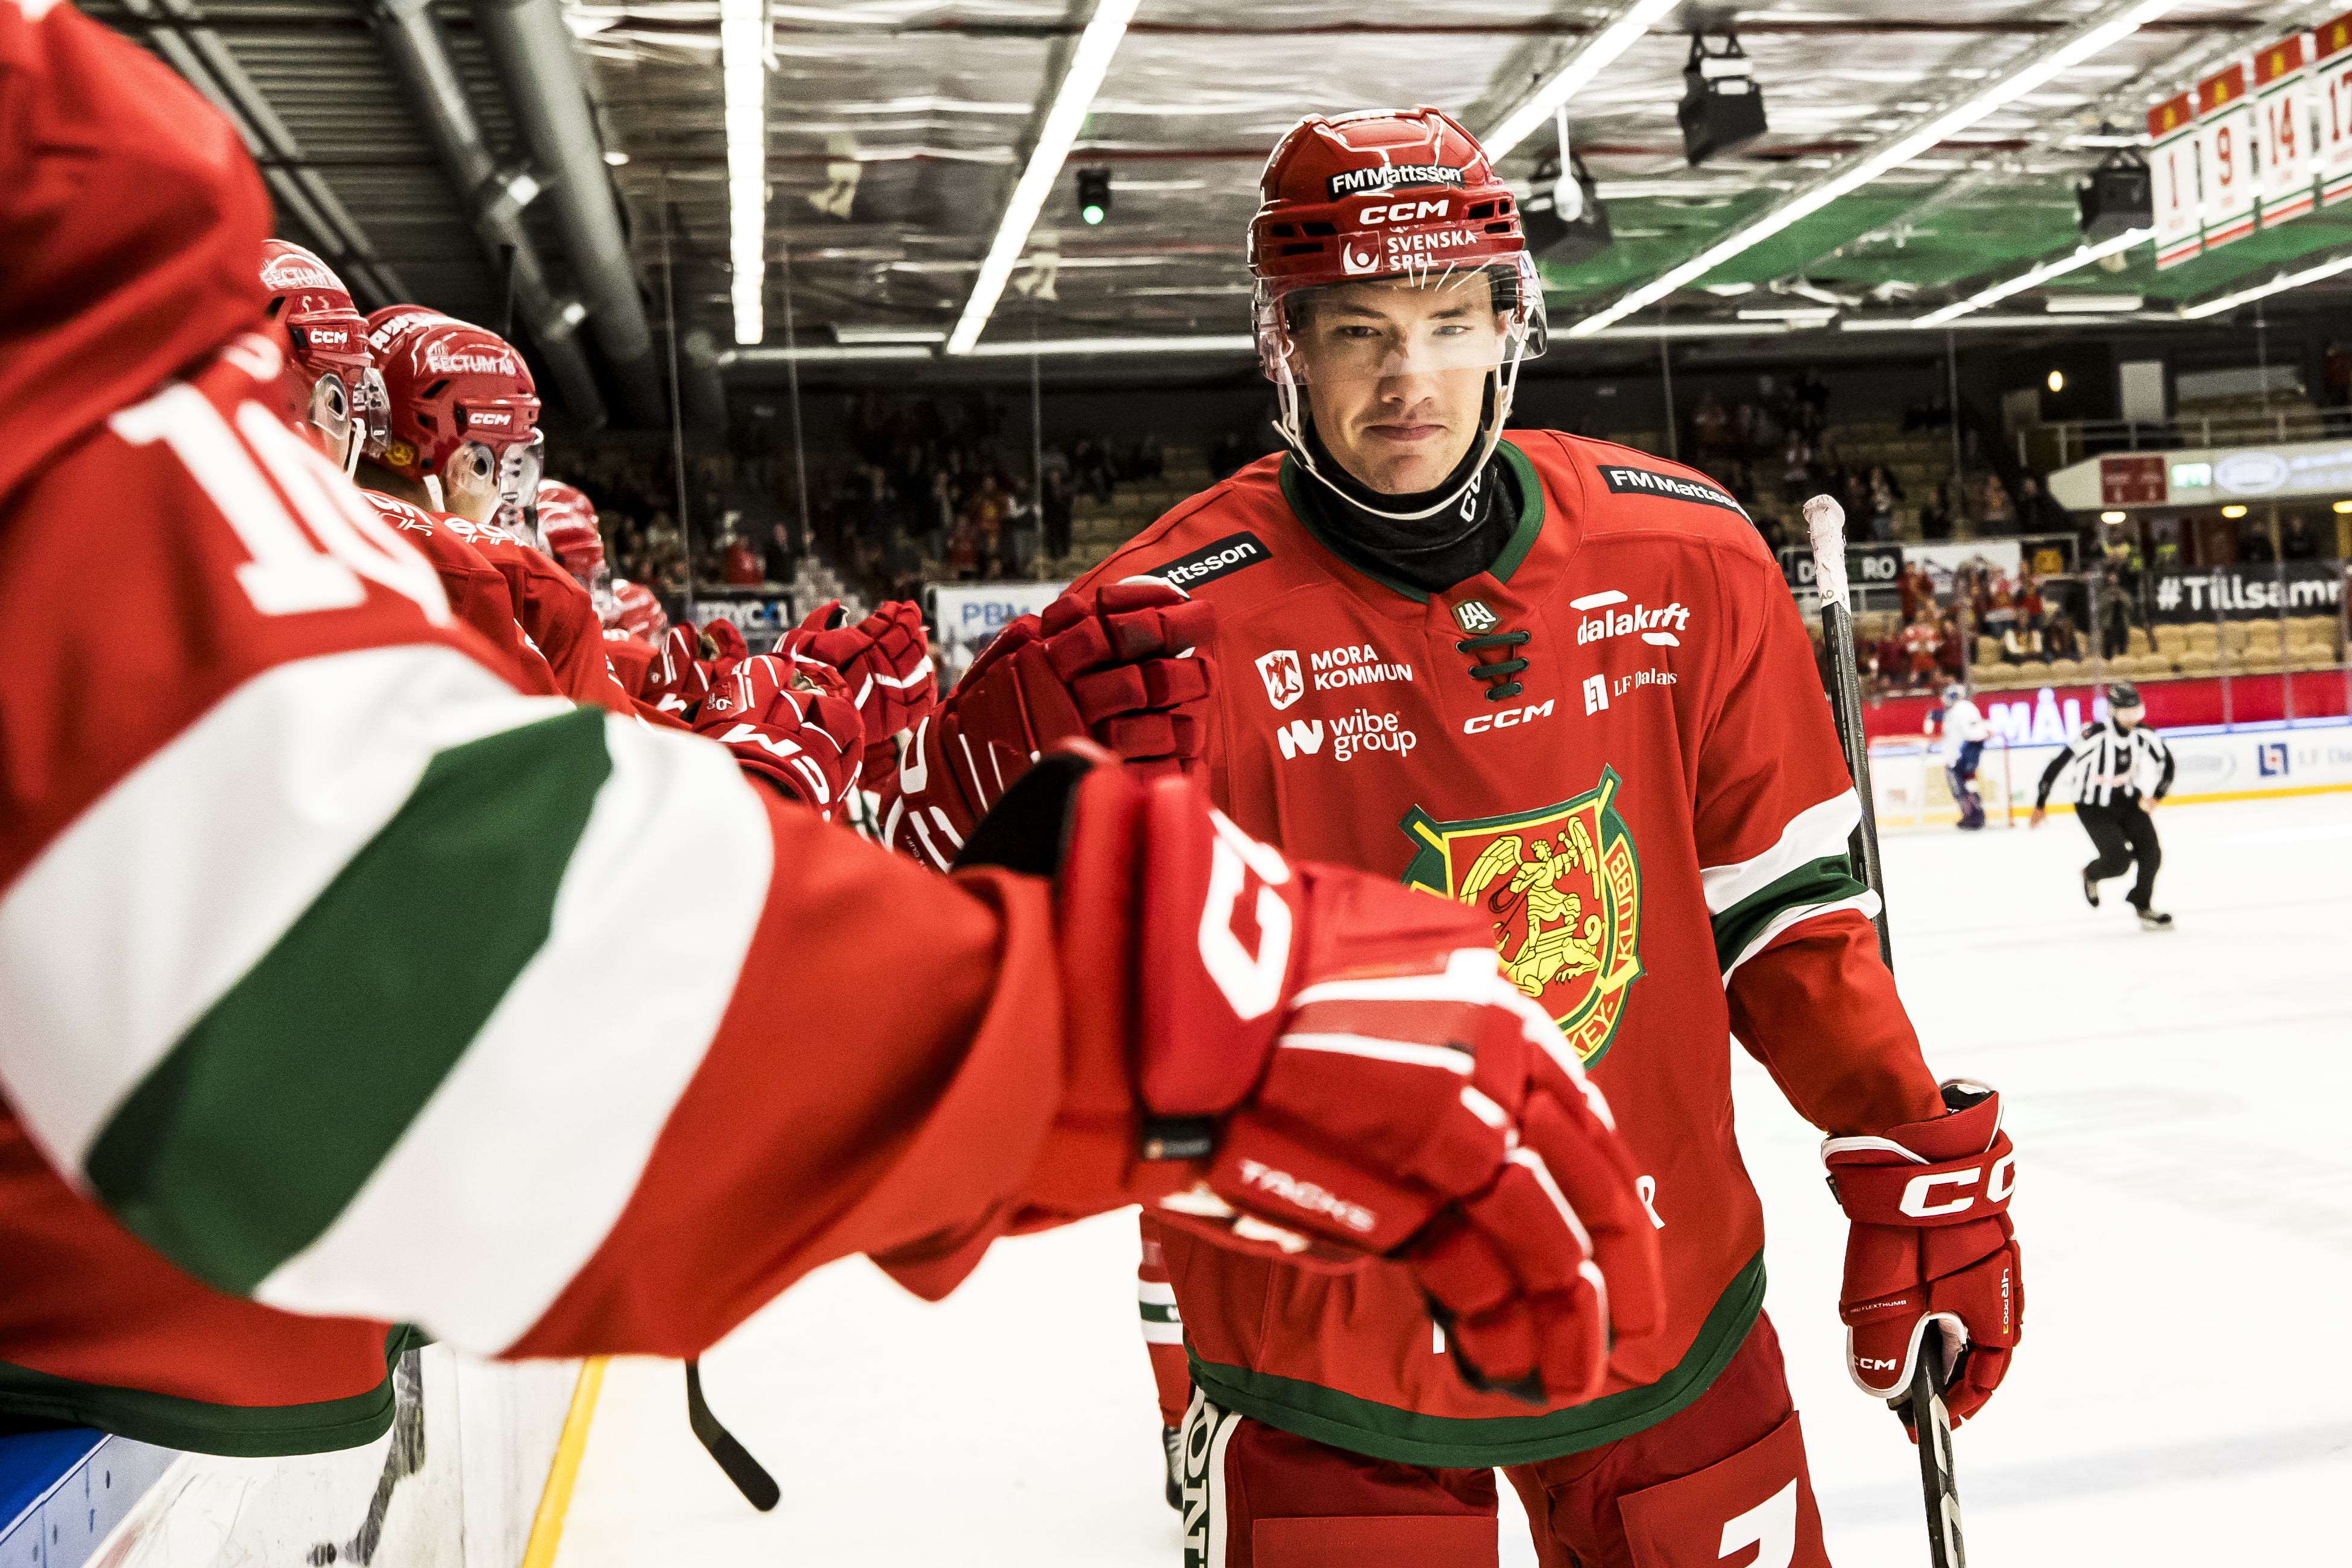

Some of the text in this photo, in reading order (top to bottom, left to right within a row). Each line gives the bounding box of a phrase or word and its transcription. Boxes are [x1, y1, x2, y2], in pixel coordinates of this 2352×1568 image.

[2216, 126, 2233, 186] 9
[2169, 151, 2180, 209] 1
[1359, 199, 1450, 225] CCM
[1387, 229, 1478, 254] SVENSKA
[1389, 251, 1440, 272] SPEL
[310, 330, 348, 344] CCM
[426, 354, 497, 373] FECTUM
[469, 412, 511, 426] CCM
[1167, 543, 1258, 584] ttsson
[1310, 644, 1379, 671] MORA
[1314, 664, 1413, 691] KOMMUN
[1613, 675, 1632, 697] LF
[1329, 708, 1399, 736] wibe
[1463, 698, 1555, 735] CCM
[1333, 730, 1417, 762] group
[1610, 850, 1634, 960] KLUBB
